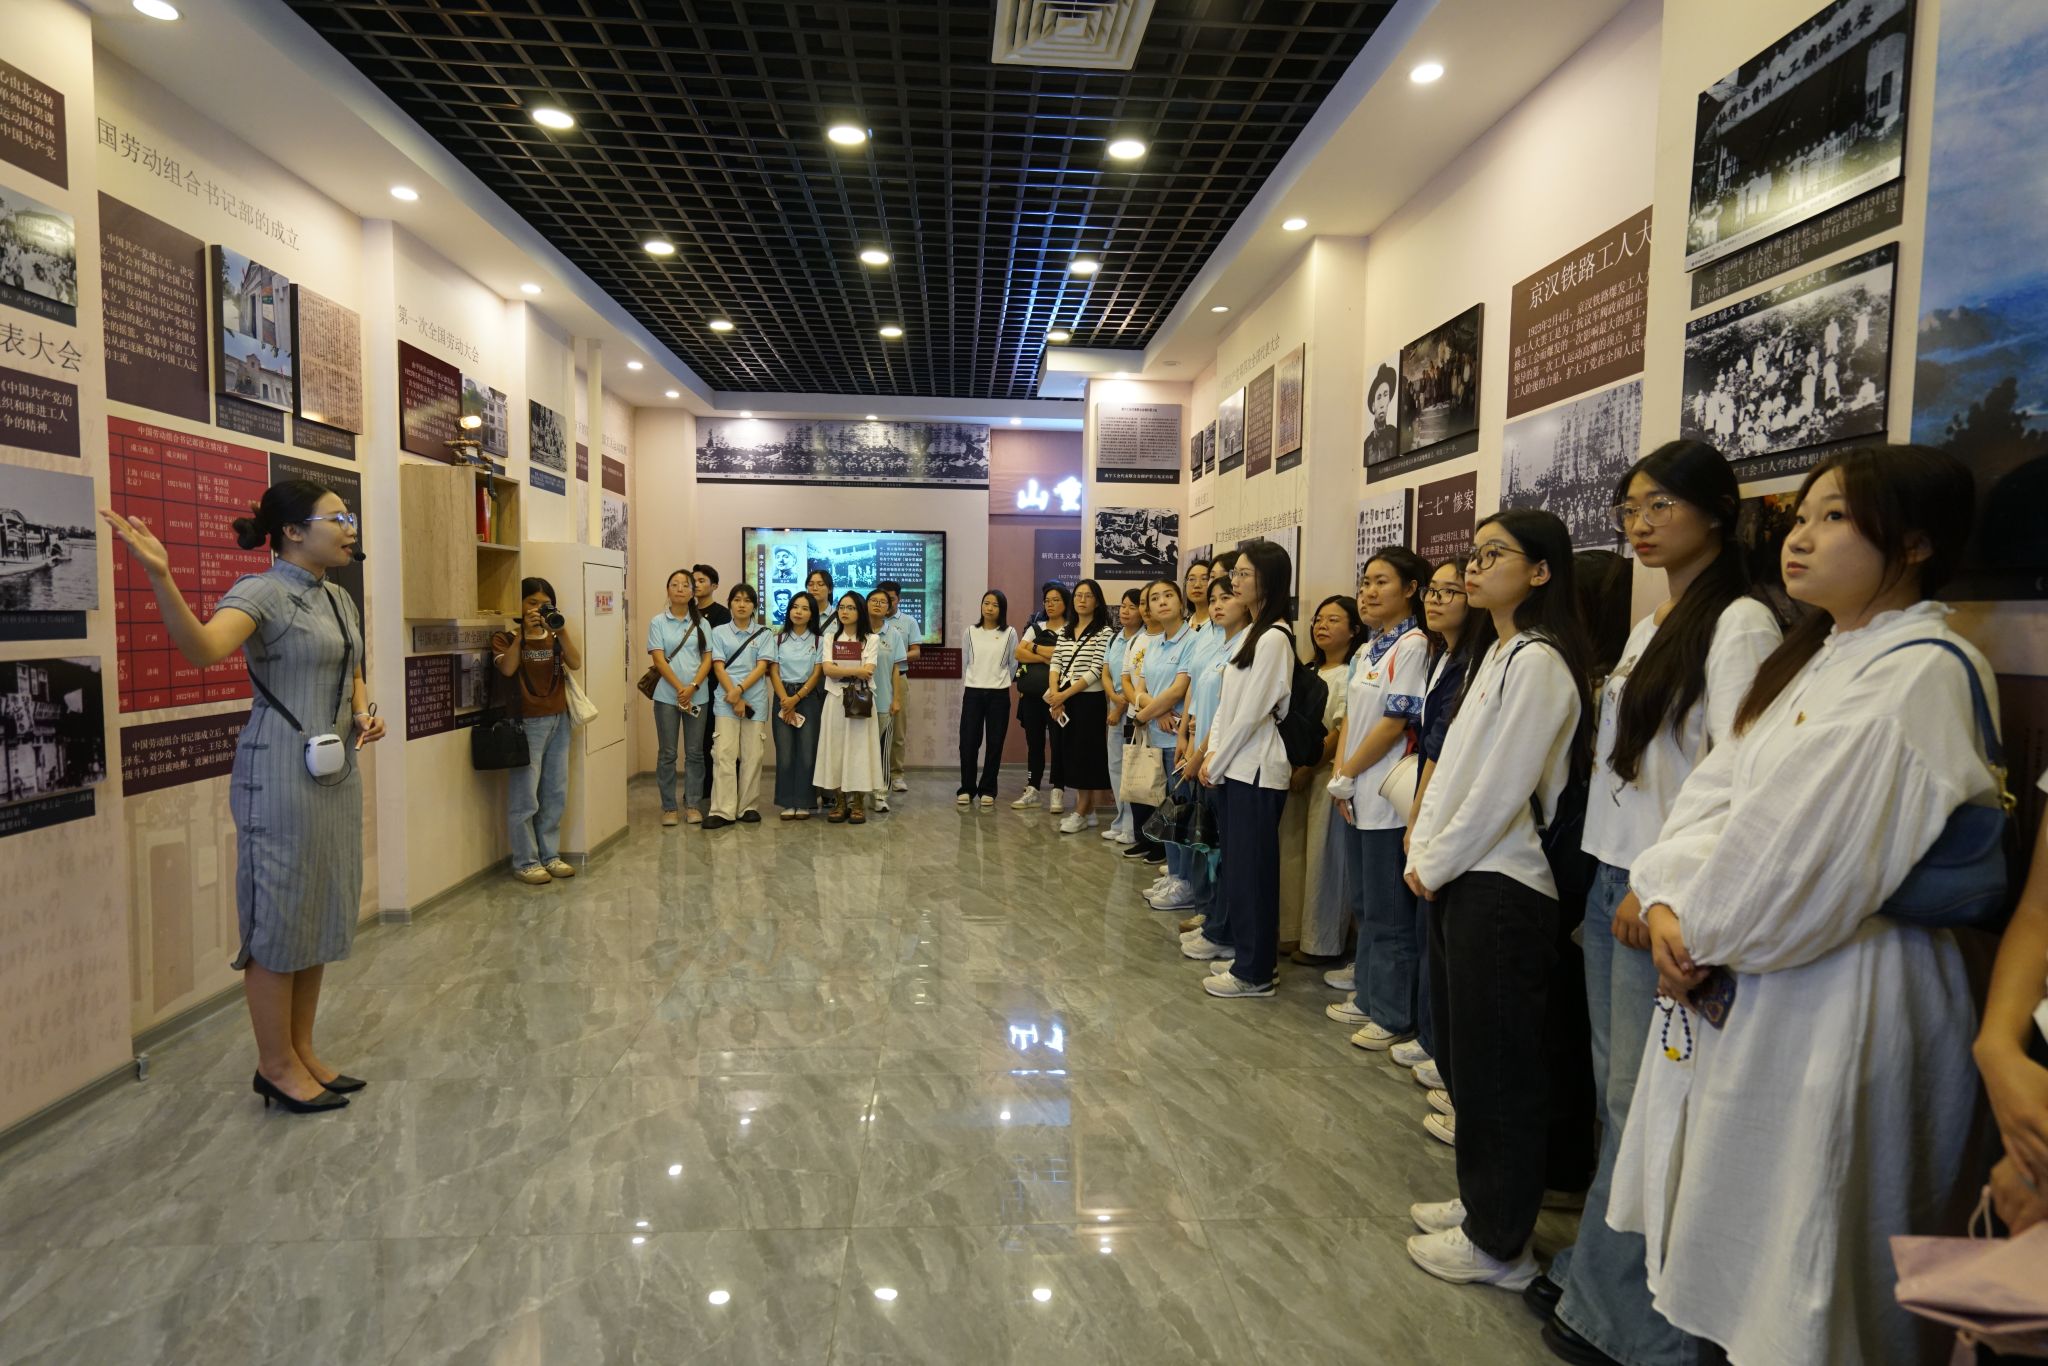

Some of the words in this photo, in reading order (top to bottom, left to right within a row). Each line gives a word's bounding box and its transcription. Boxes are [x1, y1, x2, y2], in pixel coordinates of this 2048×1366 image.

[0, 122, 56, 160] 中国共产党
[98, 117, 300, 251] 国劳动组合书记部的成立
[1529, 219, 1652, 310] 京汉铁路工人大
[0, 323, 82, 372] 表大会
[398, 305, 480, 365] 第一次全国劳动大会
[1, 379, 73, 407] 《中国共产党的
